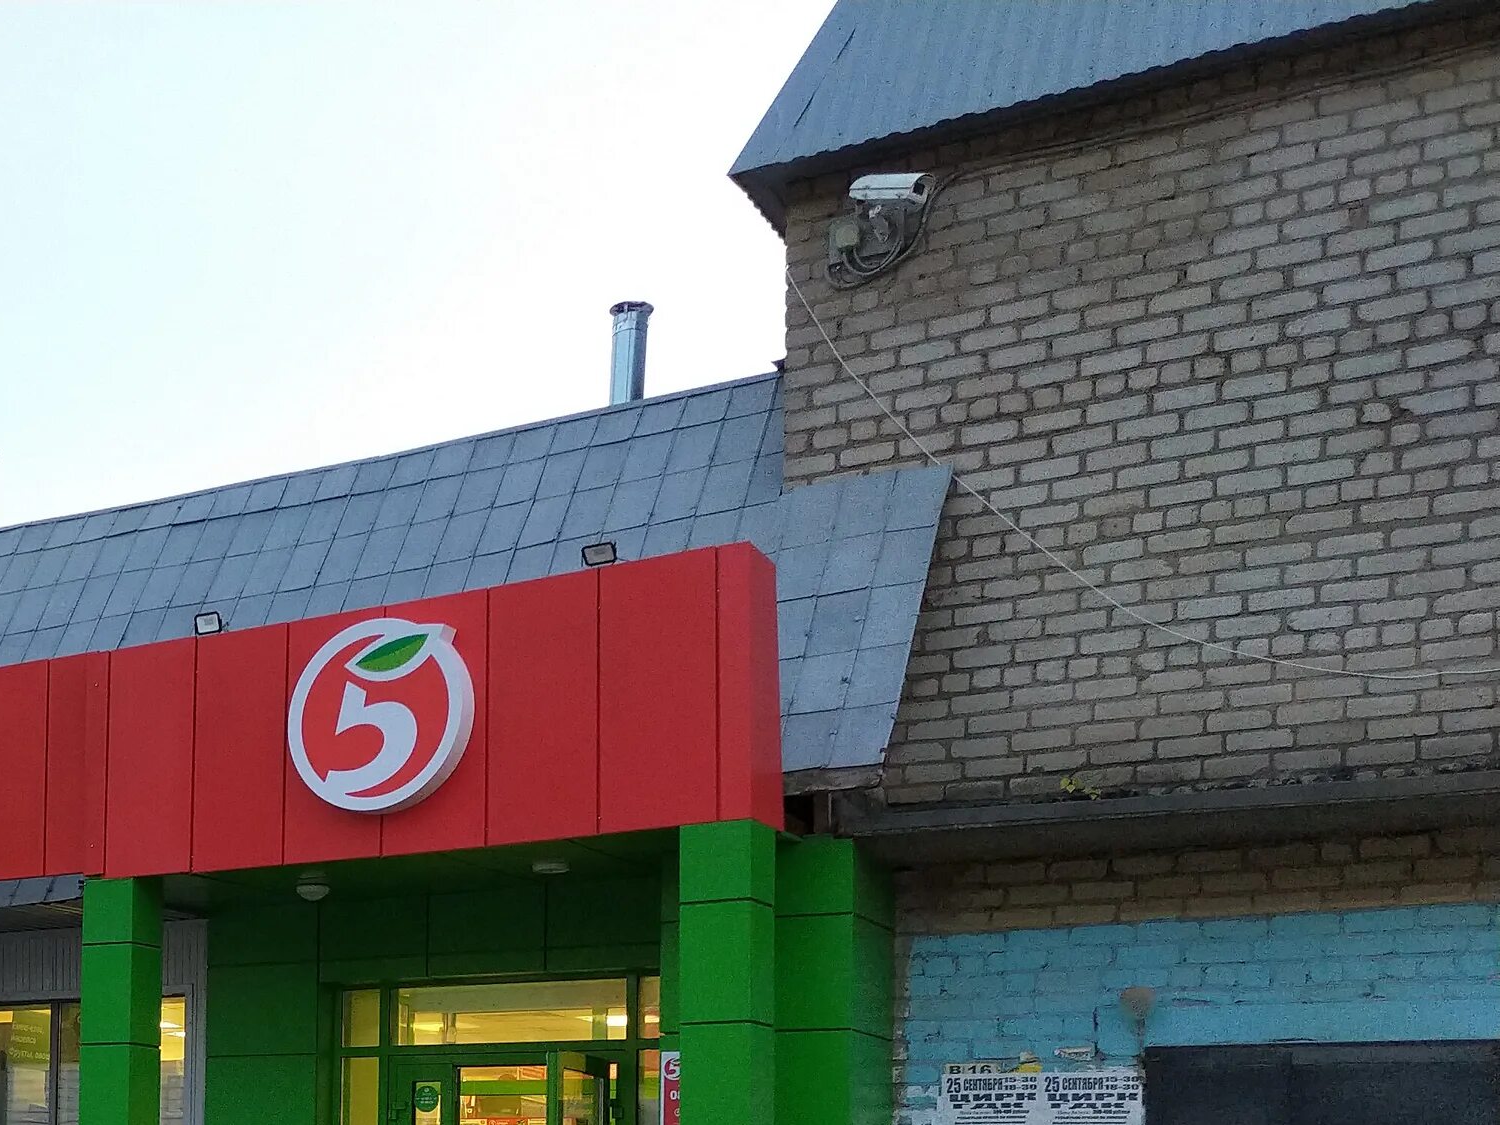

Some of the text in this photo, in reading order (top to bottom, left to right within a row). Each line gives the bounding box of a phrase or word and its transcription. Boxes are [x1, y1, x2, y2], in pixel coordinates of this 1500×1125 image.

[946, 1077, 961, 1093] 25
[963, 1077, 1003, 1091] СЕНТЯБРЯ
[1044, 1076, 1060, 1092] 25
[1062, 1076, 1104, 1090] СЕНТЯБРЯ
[949, 1092, 1037, 1103] ЦИРК
[1047, 1092, 1138, 1103] ЦИРК
[952, 1102, 1024, 1110] ГДК
[1050, 1102, 1124, 1110] ГДК
